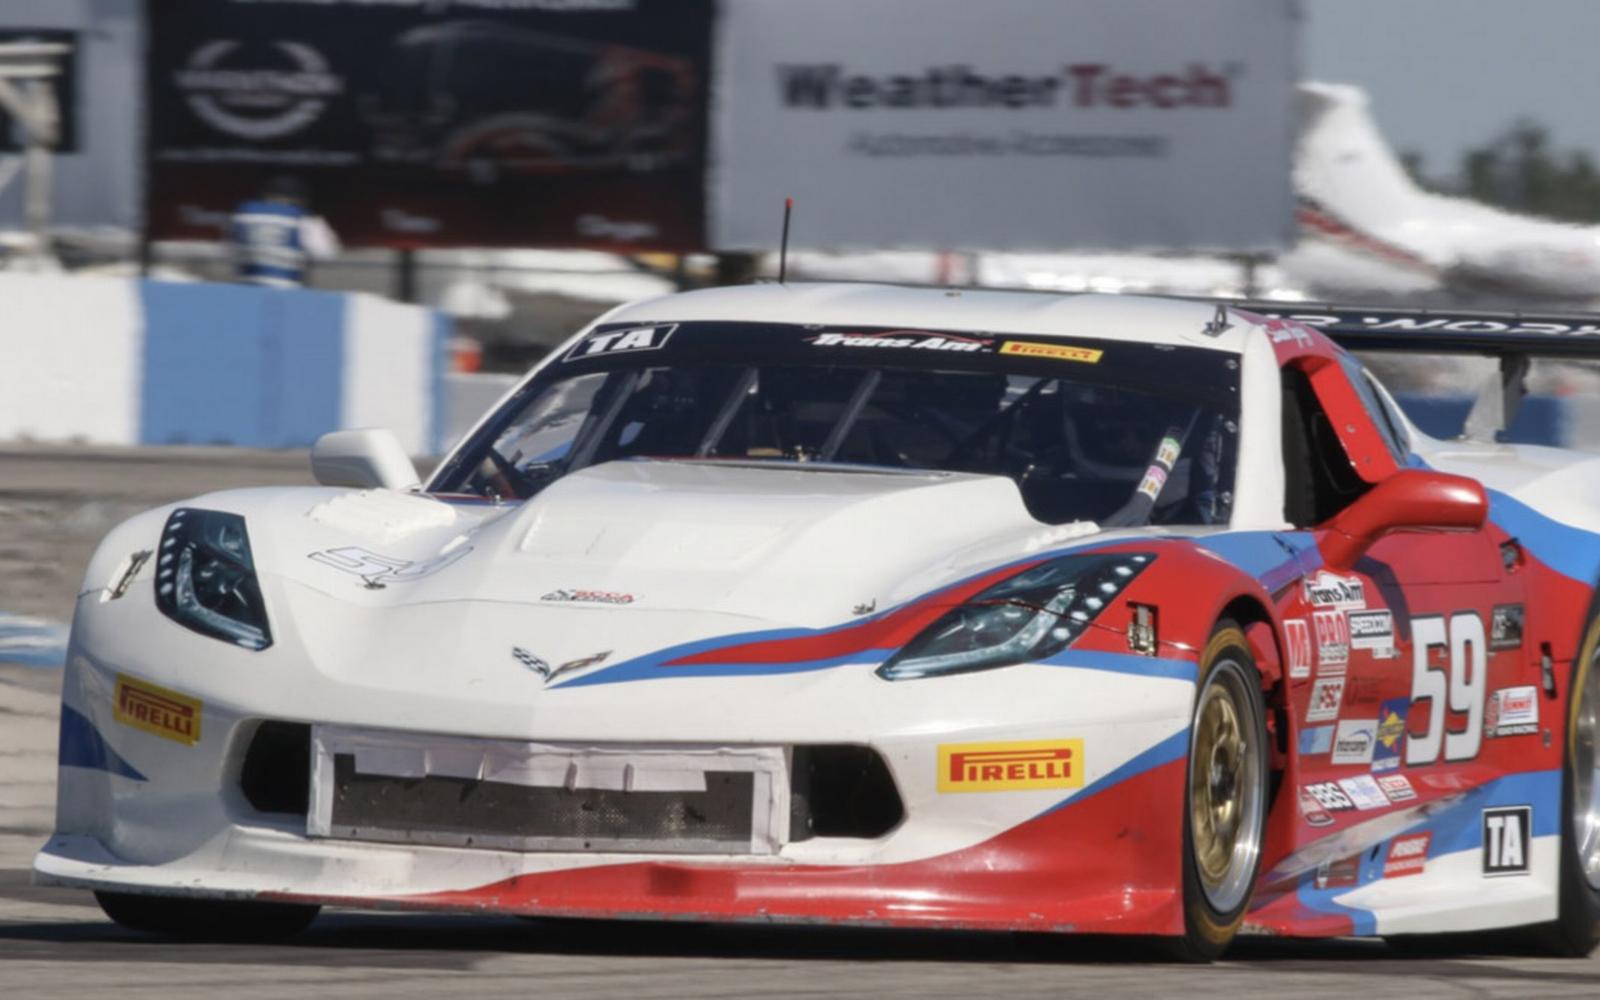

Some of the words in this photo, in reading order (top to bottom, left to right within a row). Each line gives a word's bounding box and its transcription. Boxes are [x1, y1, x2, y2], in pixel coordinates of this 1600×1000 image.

[776, 64, 1232, 109] WeatherTech
[586, 329, 655, 354] TA
[812, 333, 908, 347] Trans
[910, 337, 983, 352] Am
[1010, 343, 1092, 360] PIRELLI
[1406, 610, 1487, 767] 59
[119, 683, 194, 736] PIRELLI
[950, 748, 1072, 782] PIRELLI
[1487, 815, 1523, 867] TA
